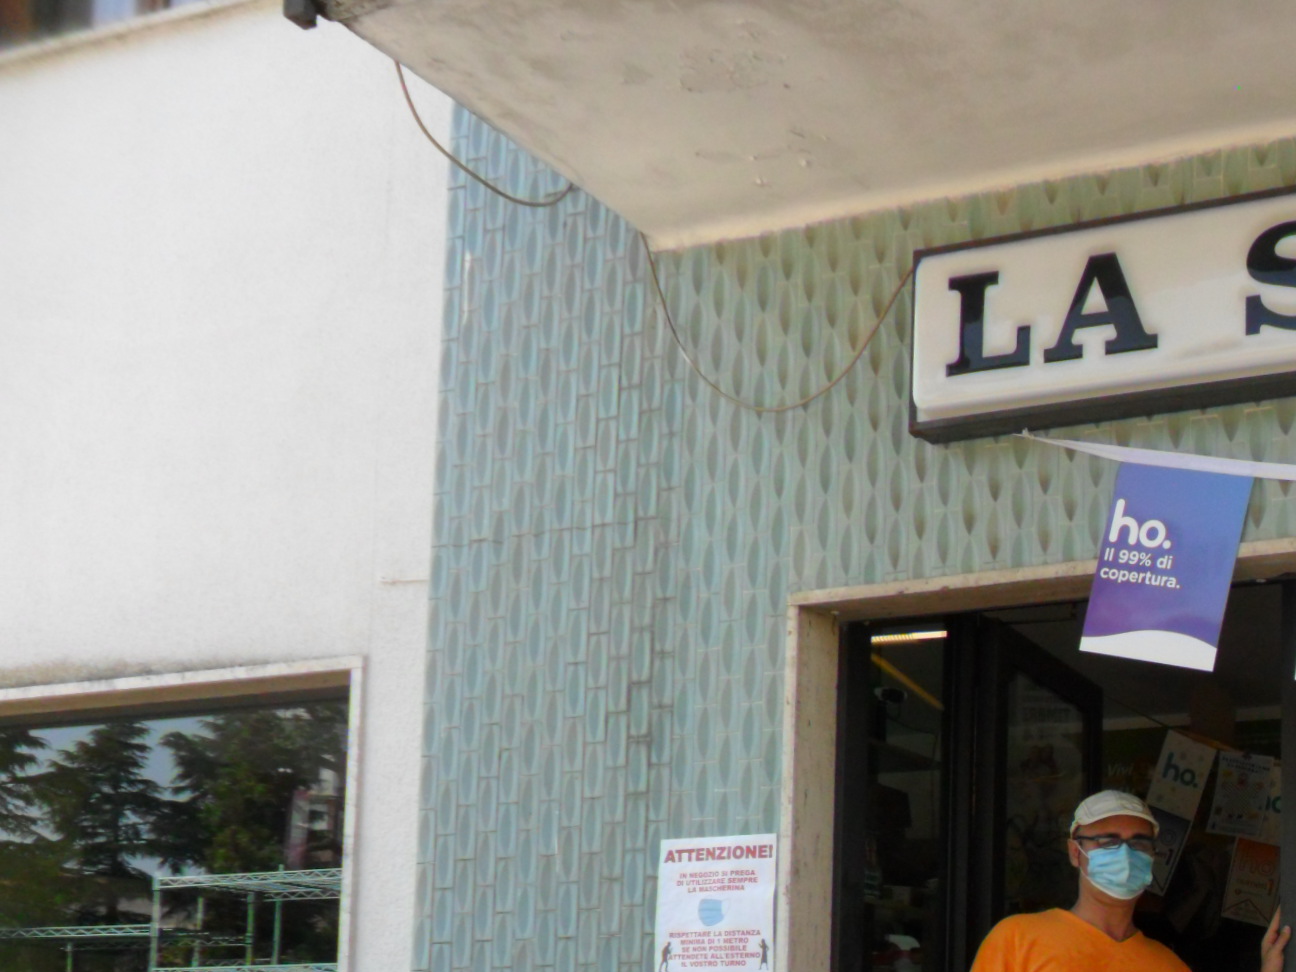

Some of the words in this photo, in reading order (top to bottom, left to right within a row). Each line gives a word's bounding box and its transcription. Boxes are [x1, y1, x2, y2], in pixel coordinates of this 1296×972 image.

[945, 250, 1158, 376] LA
[1109, 499, 1171, 550] ho.
[1104, 548, 1114, 561] Il
[1119, 550, 1151, 566] 99%
[1157, 556, 1172, 569] di
[1100, 567, 1180, 588] copertura.
[1162, 752, 1198, 788] ho.
[664, 845, 773, 863] ATTENZIONE!
